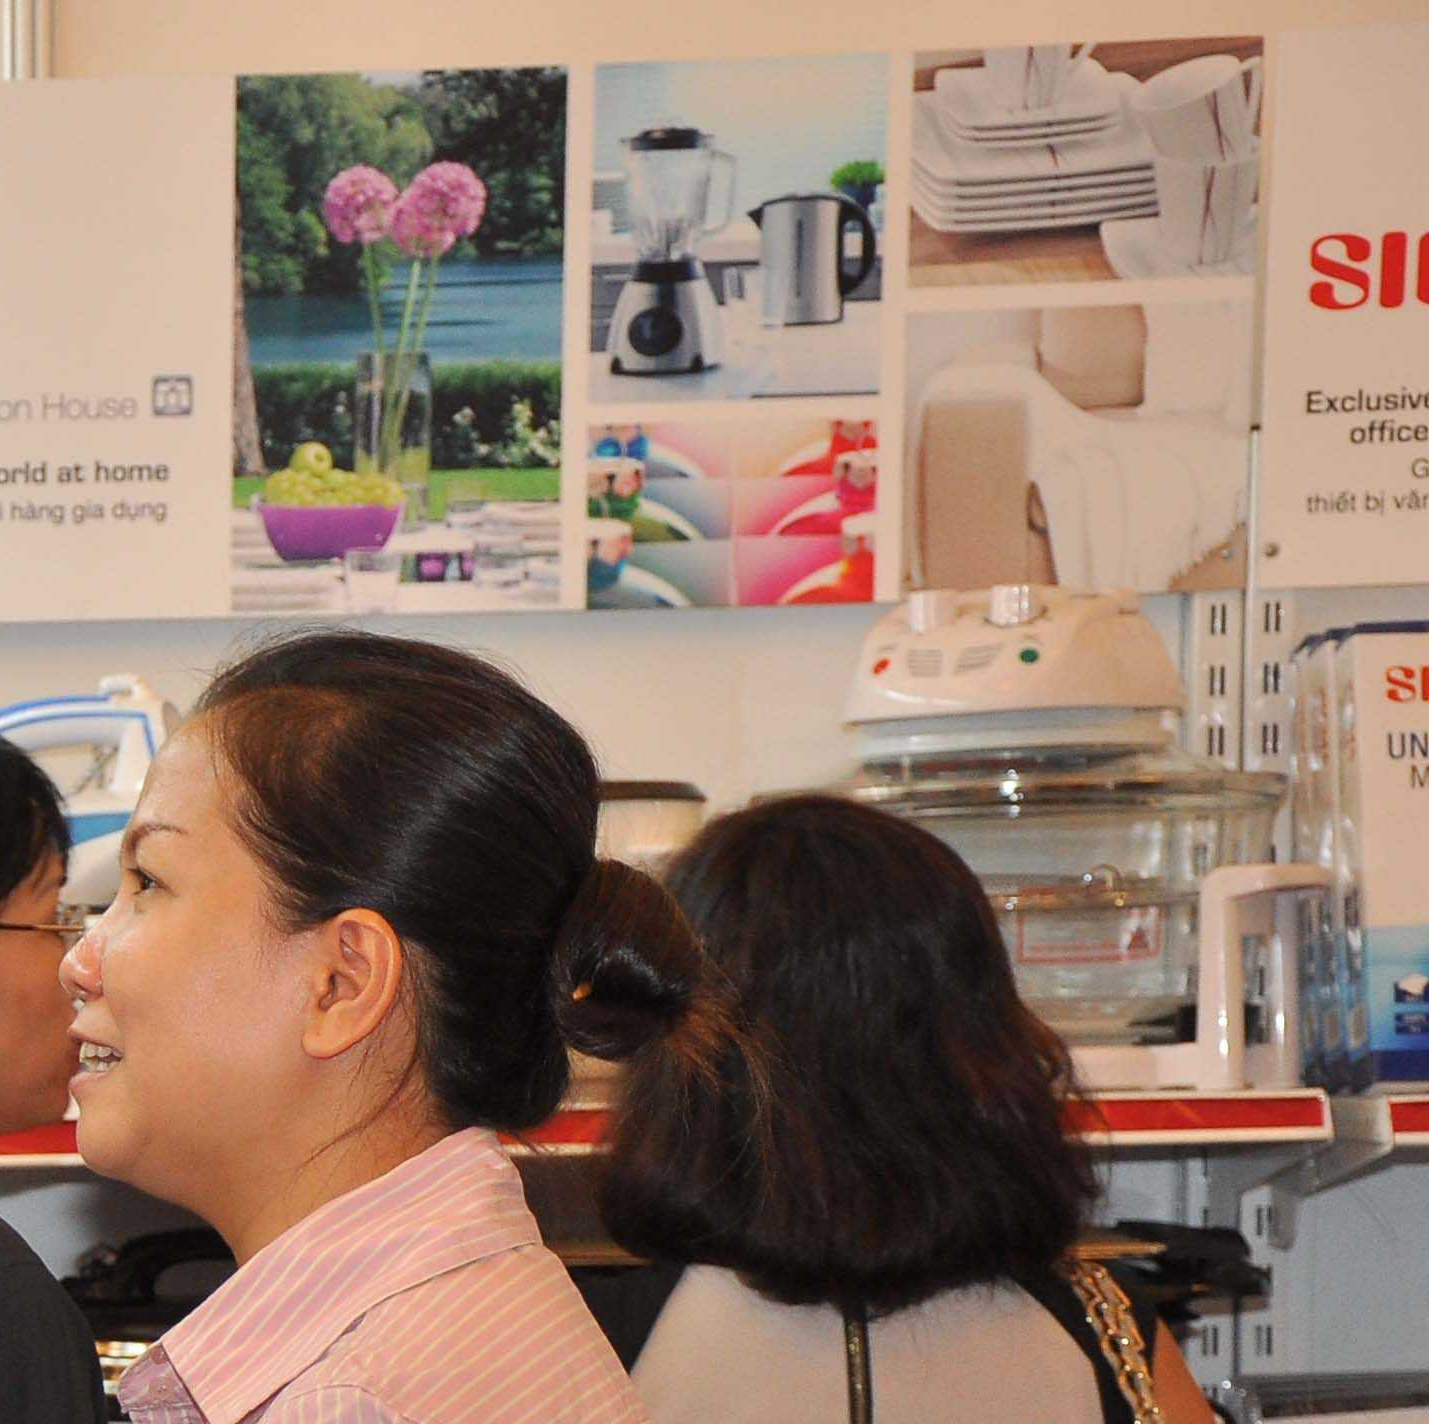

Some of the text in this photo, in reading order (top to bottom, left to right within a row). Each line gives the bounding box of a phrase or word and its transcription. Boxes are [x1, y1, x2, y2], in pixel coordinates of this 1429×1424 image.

[1308, 231, 1429, 310] SI
[42, 394, 138, 420] House
[1349, 419, 1429, 445] office
[56, 463, 90, 484] at
[94, 460, 170, 483] home
[9, 498, 65, 526] hàng
[72, 498, 105, 526] gia
